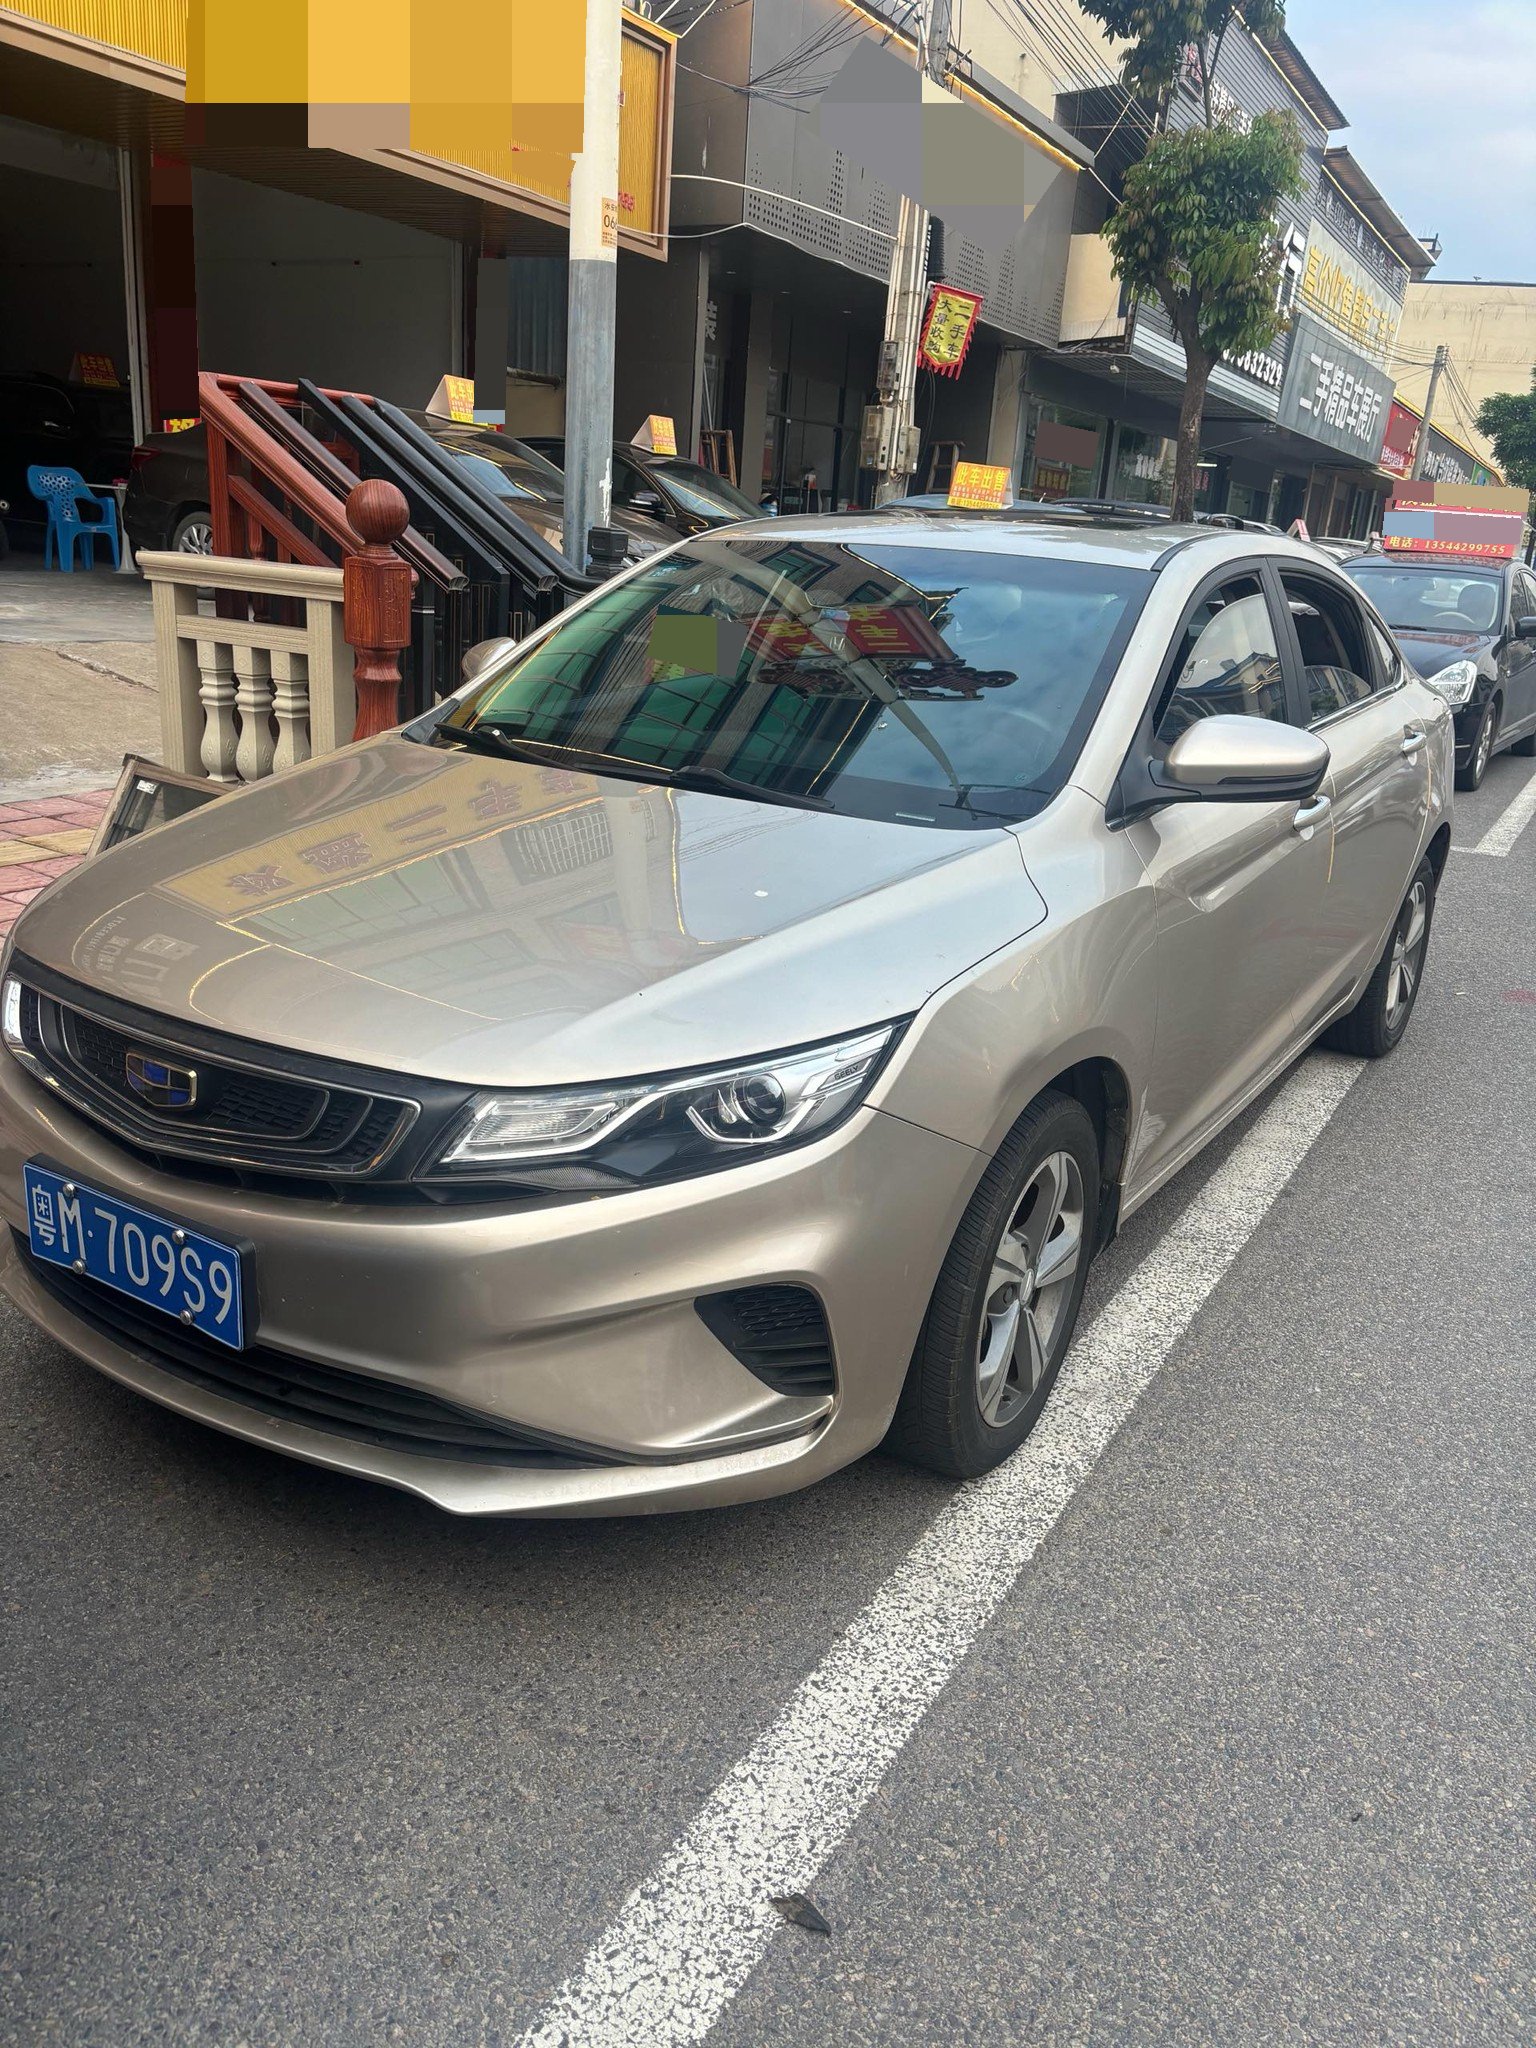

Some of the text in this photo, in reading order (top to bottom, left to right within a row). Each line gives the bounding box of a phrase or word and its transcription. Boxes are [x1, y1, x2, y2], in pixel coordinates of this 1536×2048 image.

[603, 214, 617, 229] 06
[926, 299, 953, 353] 大量收购
[944, 304, 971, 358] 二手车
[1299, 352, 1382, 443] 二手精品车展厅
[955, 465, 1006, 491] 此车出售
[31, 1184, 233, 1325] 粤M·709S9
